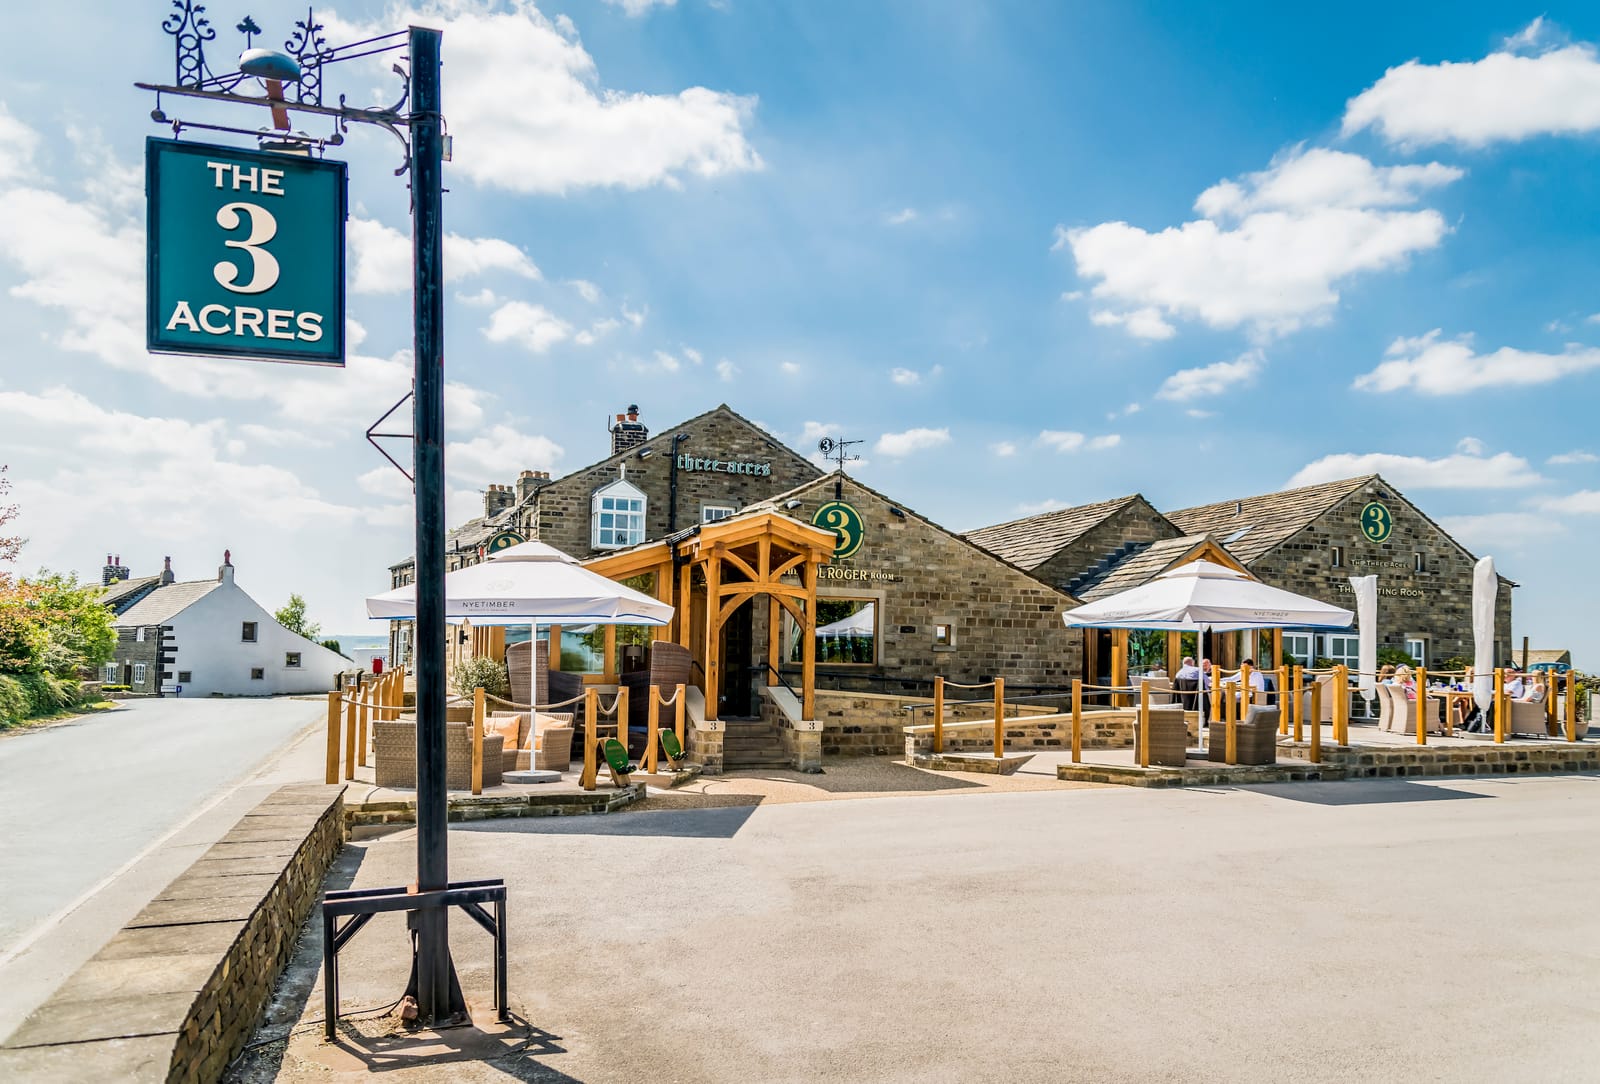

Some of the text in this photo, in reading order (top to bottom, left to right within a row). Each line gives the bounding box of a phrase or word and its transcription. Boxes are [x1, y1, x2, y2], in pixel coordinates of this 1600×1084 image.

[207, 161, 285, 196] THE
[213, 202, 280, 294] 3
[166, 301, 324, 342] ACRES
[677, 453, 771, 477] three acres
[827, 509, 851, 551] 3
[1368, 507, 1385, 538] 3
[827, 567, 868, 580] ROGER
[870, 572, 894, 580] ROOM
[1400, 588, 1424, 597] ROOM
[710, 722, 717, 731] 3
[808, 722, 815, 730] 3
